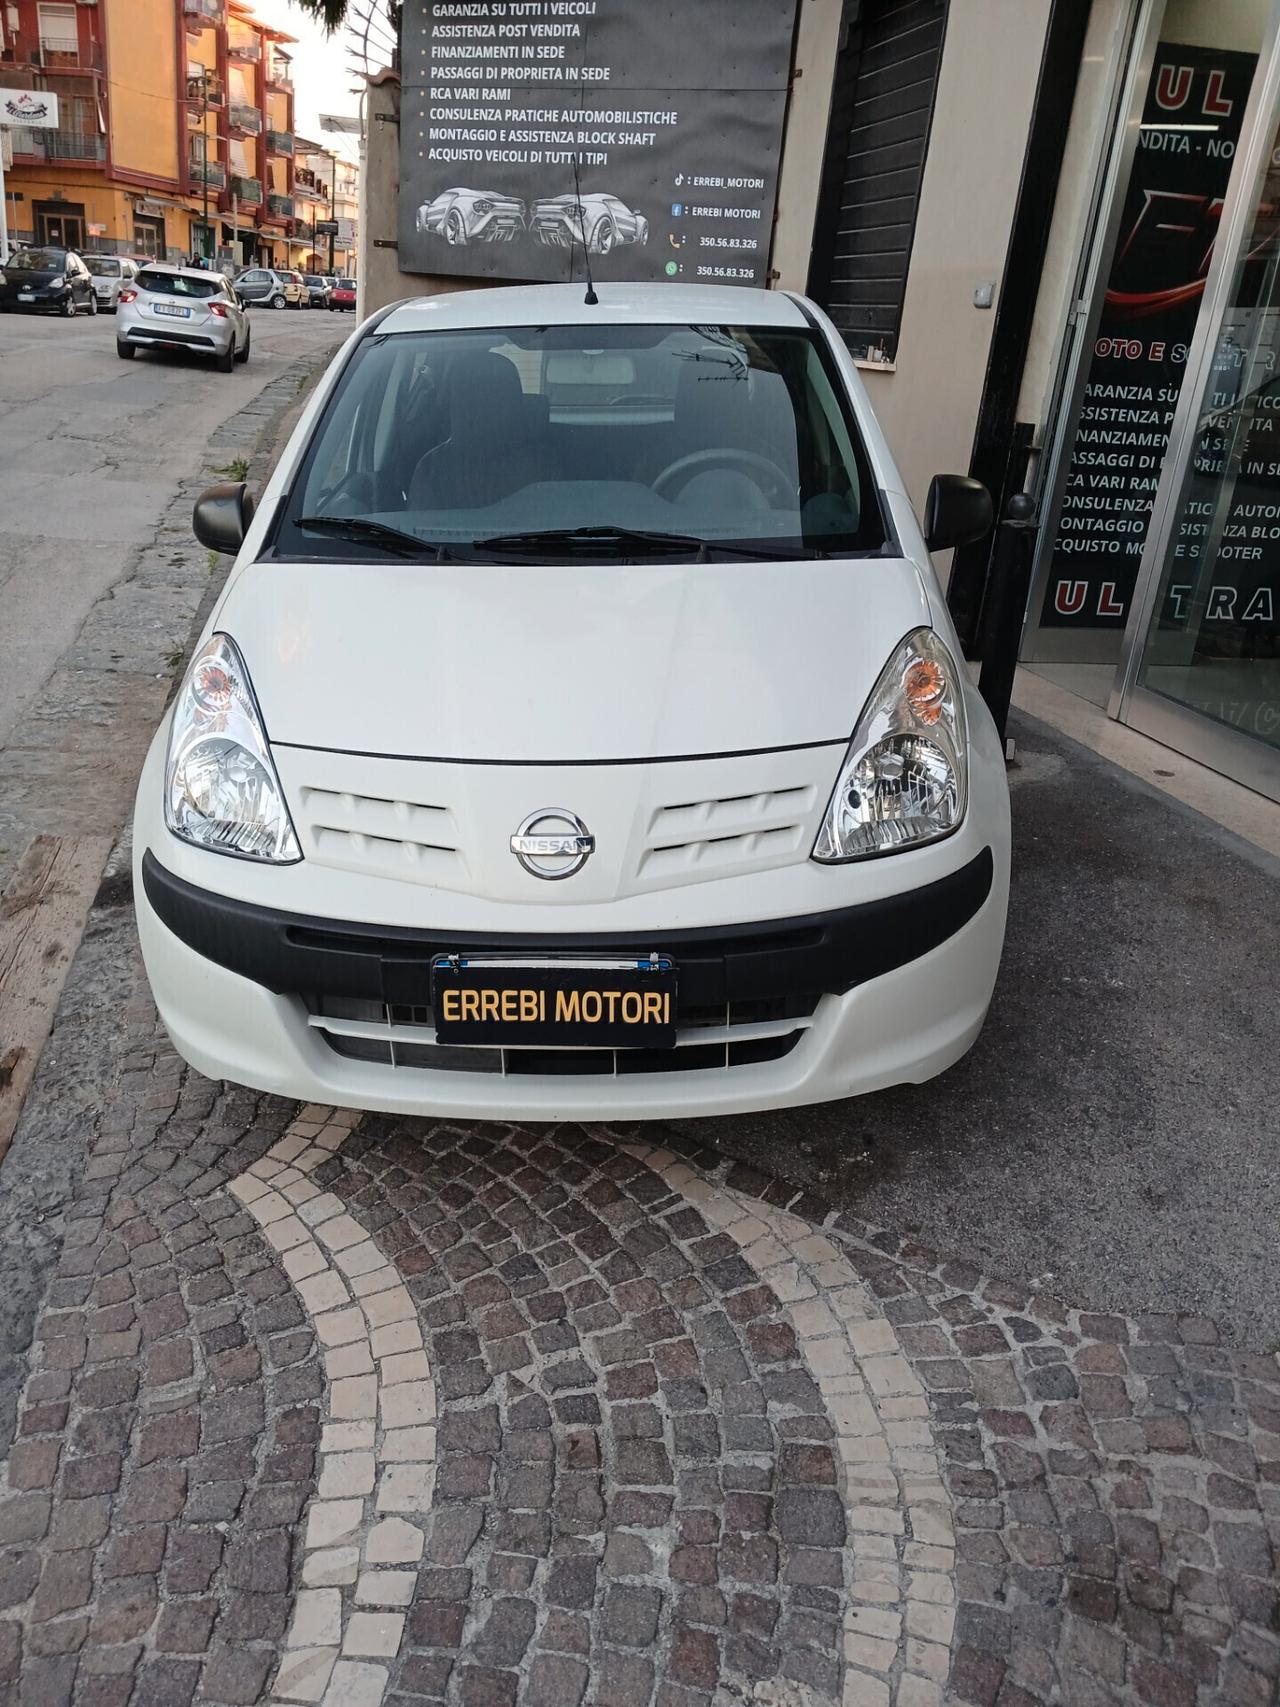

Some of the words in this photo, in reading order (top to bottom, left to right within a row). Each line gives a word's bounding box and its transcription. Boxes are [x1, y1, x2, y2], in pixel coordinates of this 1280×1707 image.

[432, 4, 489, 17] GARANZIA
[491, 3, 506, 16] SU
[509, 3, 541, 16] TUTTI
[543, 2, 548, 15] I
[550, 2, 596, 15] VEICOLI
[431, 24, 496, 38] ASSISTENZA
[498, 24, 528, 38] POST
[530, 24, 581, 37] VENDITA
[431, 46, 519, 59] FINANZIAMENTI
[521, 46, 535, 59] IN
[536, 45, 566, 59] SEDE
[430, 66, 483, 79] PASSAGGI
[485, 67, 498, 80] DI
[500, 67, 563, 80] PROPRIETA
[565, 67, 579, 80] IN
[581, 67, 611, 81] SEDE
[430, 87, 452, 100] RCA
[453, 88, 479, 101] VARI
[482, 88, 512, 101] RAMI
[429, 107, 503, 121] CONSULENZA
[504, 109, 560, 122] PRATICHE
[560, 110, 678, 125] AUTOMOBILISTICHE
[429, 127, 498, 141] MONTAGGIO
[499, 129, 507, 142] E
[508, 130, 575, 144] ASSISTENZA
[577, 131, 616, 145] BLOCK
[617, 132, 657, 146] SHAFT
[1139, 130, 1190, 155] NDITA
[1206, 137, 1236, 159] NO
[428, 147, 483, 163] ACQUISTO
[485, 149, 528, 163] VEICOLI
[530, 151, 542, 164] DI
[544, 151, 577, 165] TUTTI
[585, 152, 608, 166] TIPI
[693, 176, 765, 189] ERREBI_MOTORI
[692, 206, 723, 218] ERREBI
[724, 208, 761, 219] MOTORI
[699, 236, 758, 249] 350.56.83.326
[696, 265, 755, 279] 350.56.83.326
[1094, 337, 1143, 360] OTO
[1148, 341, 1166, 361] E
[1170, 343, 1191, 363] S
[1085, 384, 1153, 401] ARANZIA
[1157, 388, 1179, 403] SU
[1080, 406, 1159, 425] SSISTENZA
[1138, 455, 1156, 469] DI
[1246, 462, 1264, 475] IN
[1089, 474, 1126, 489] VARI
[1062, 496, 1154, 512] ONSULENZA
[1060, 516, 1145, 534] ONTAGGIO
[1180, 523, 1247, 537] SISTNZA
[1250, 526, 1280, 539] BLO
[1174, 544, 1186, 558] E
[519, 839, 587, 852] NISSAN
[442, 989, 545, 1022] ERREBI
[555, 990, 670, 1024] MOTORI
